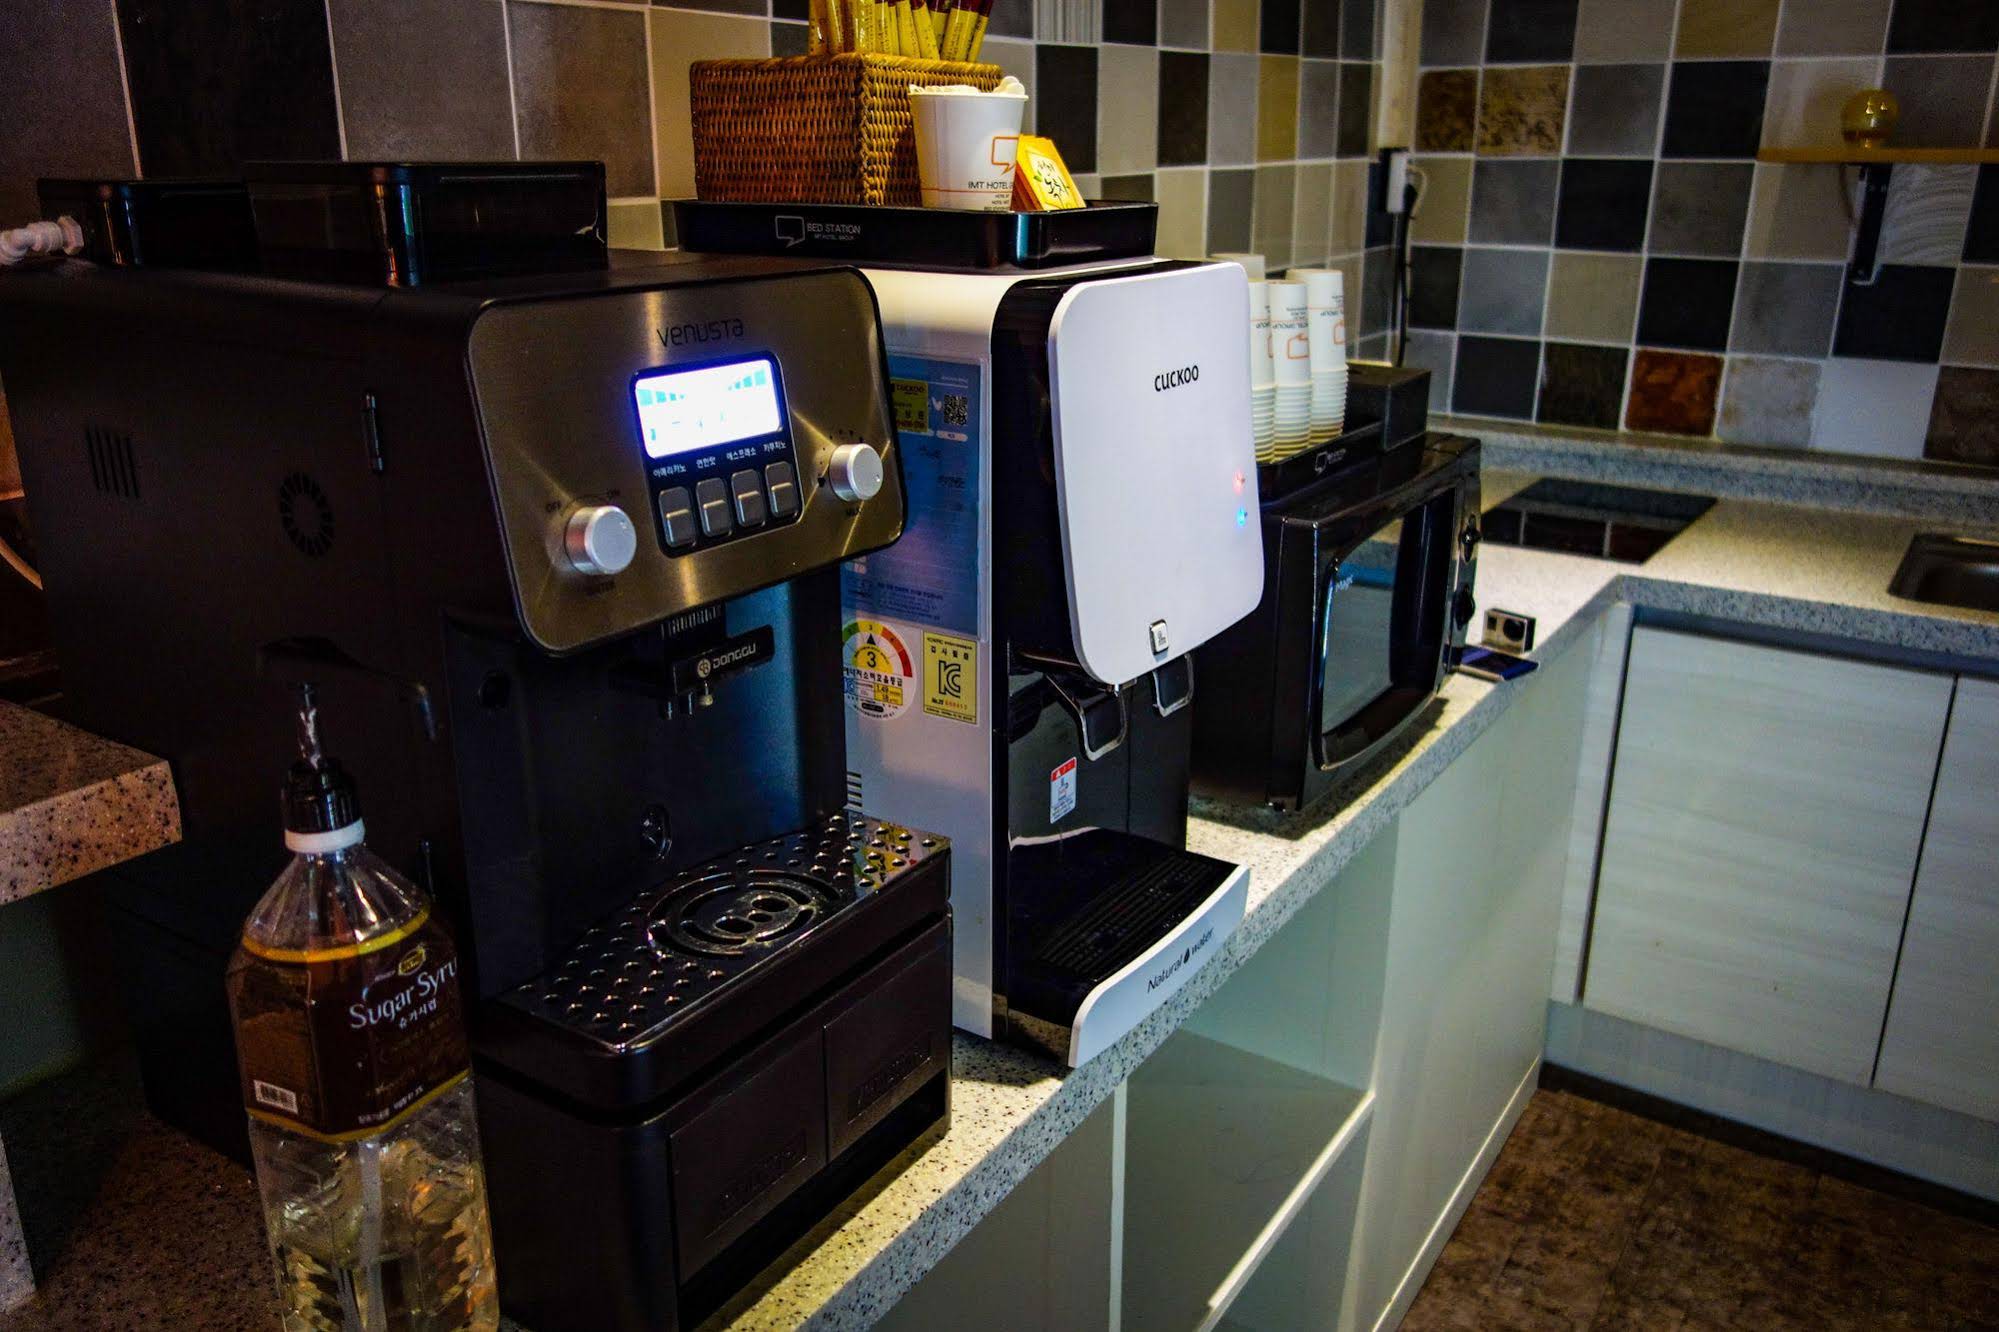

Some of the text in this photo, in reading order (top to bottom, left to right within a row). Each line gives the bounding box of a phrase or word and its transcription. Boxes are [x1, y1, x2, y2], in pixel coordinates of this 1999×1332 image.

[986, 181, 1009, 190] HOTEL
[806, 222, 861, 235] BED STATION
[866, 651, 877, 668] 3
[1146, 953, 1184, 993] Natural
[349, 983, 415, 1029] Sugar
[417, 956, 457, 999] Syru
